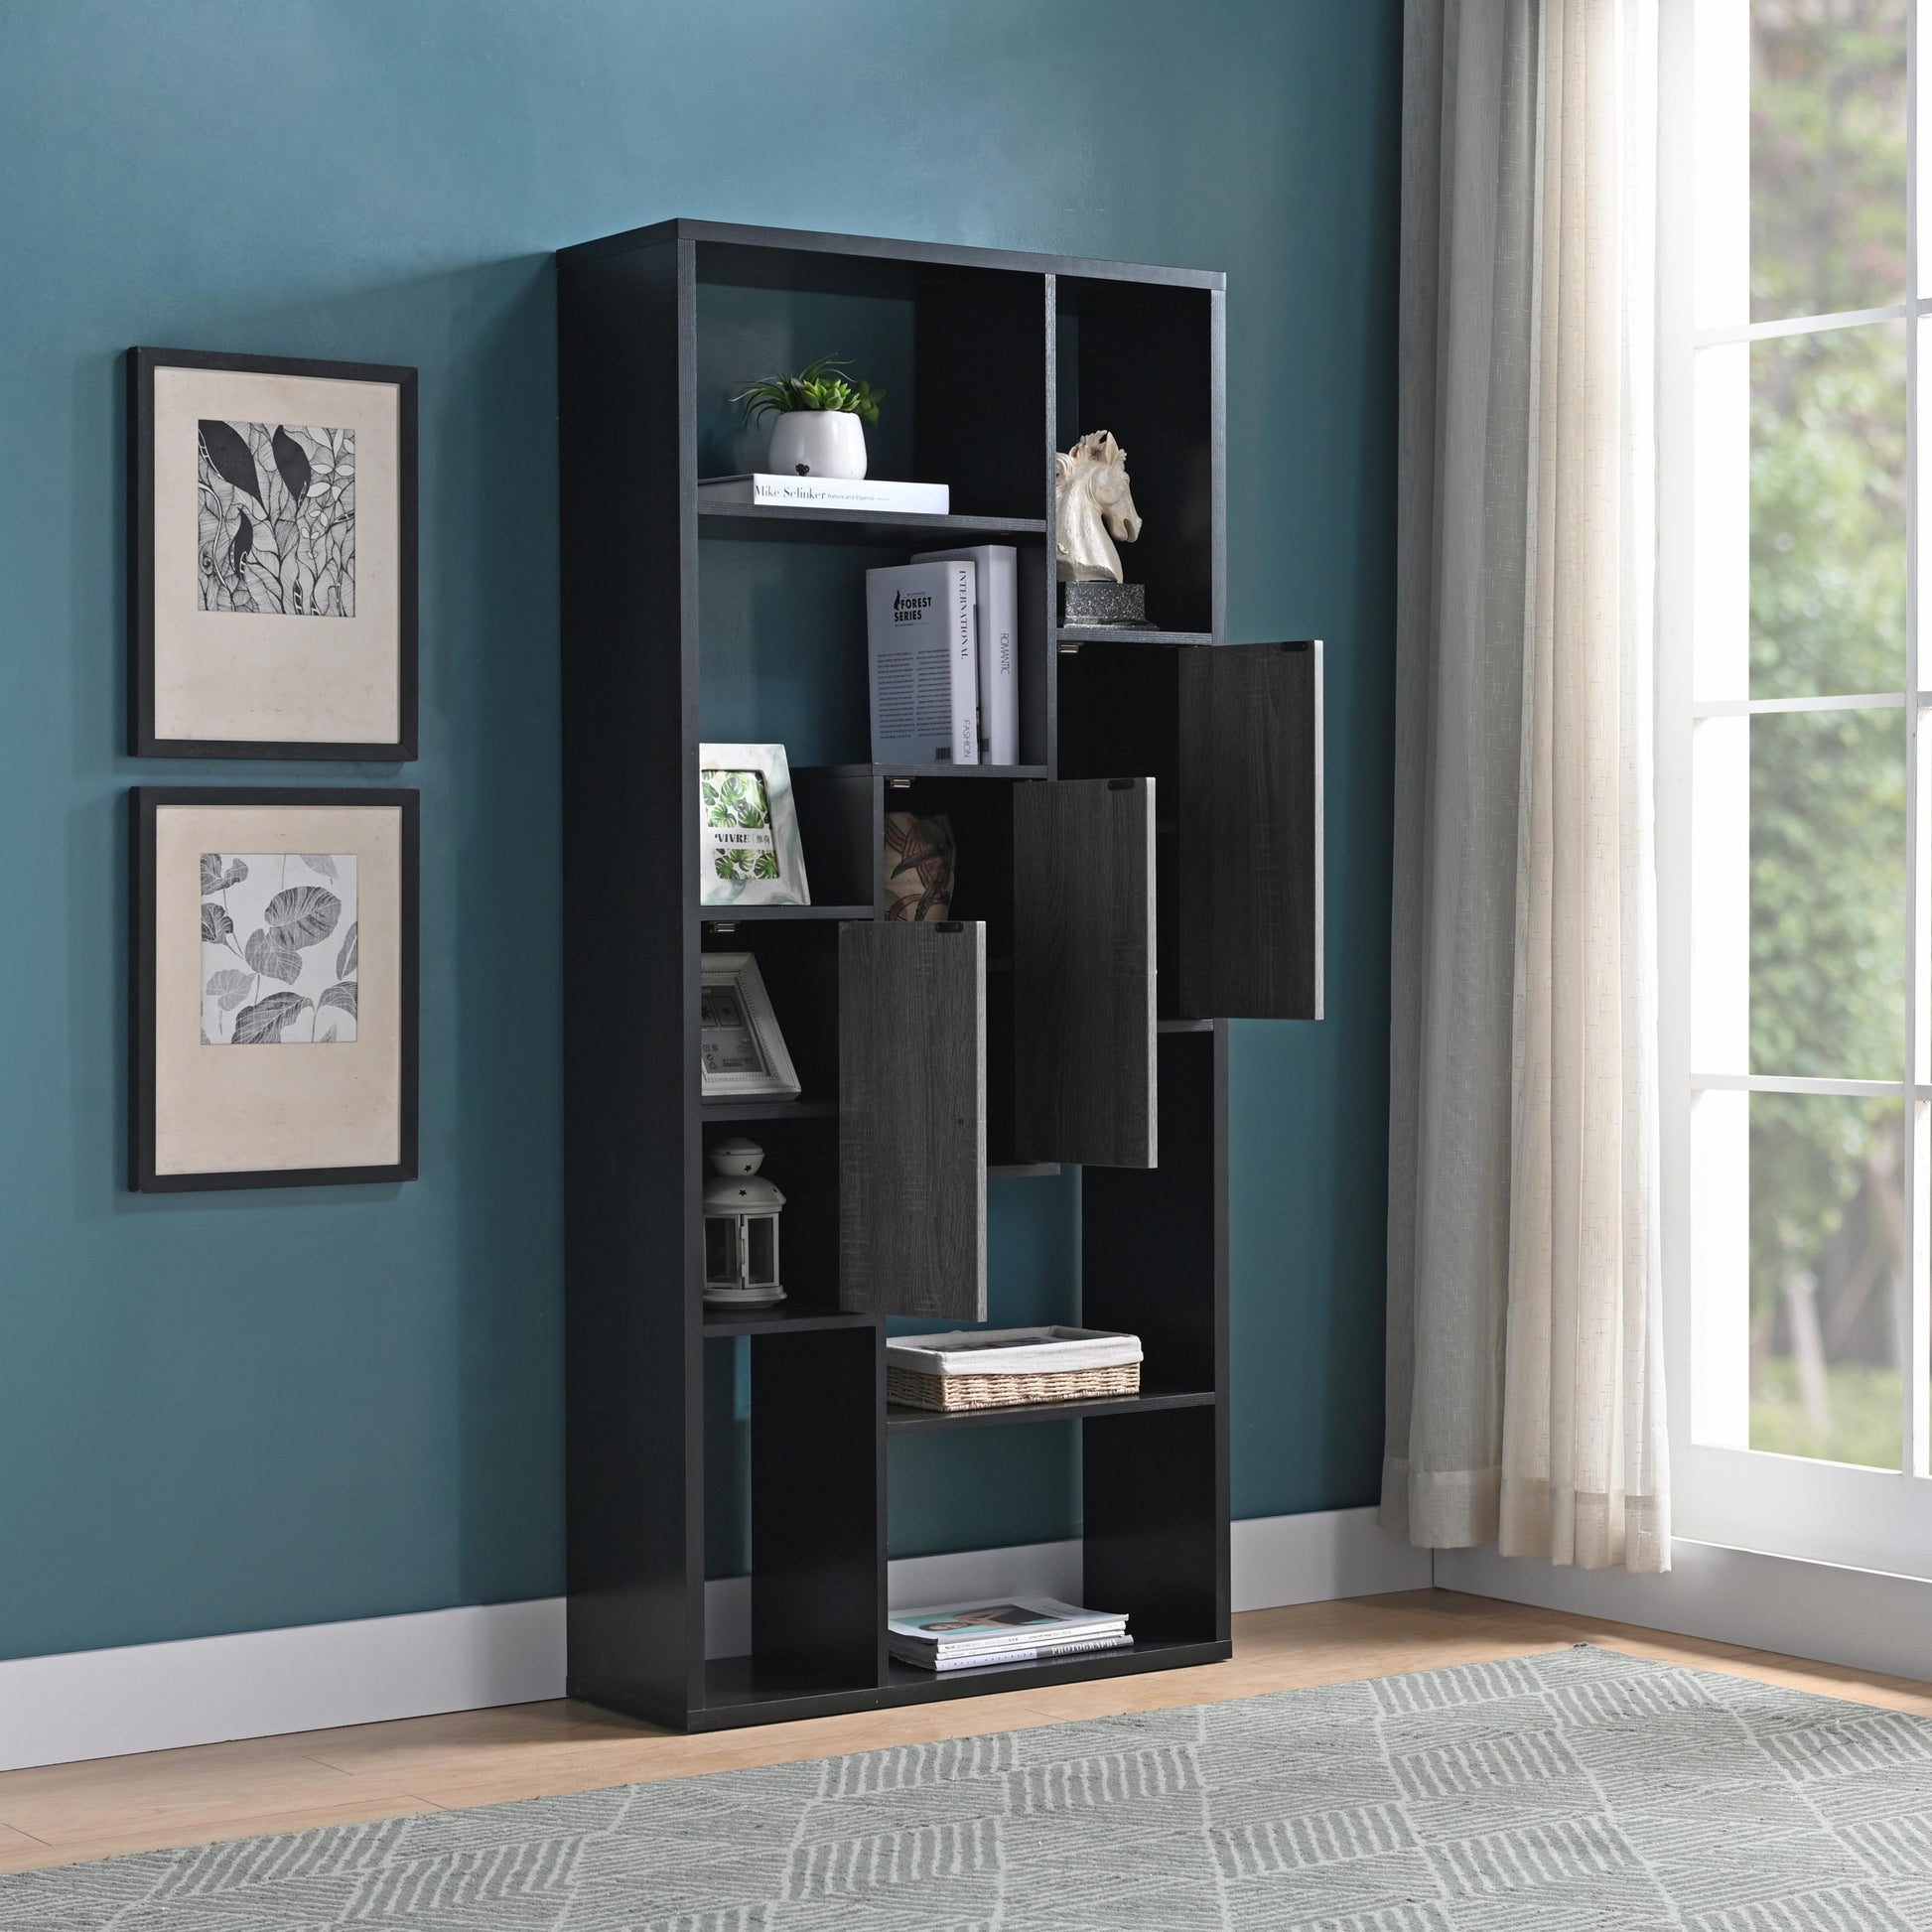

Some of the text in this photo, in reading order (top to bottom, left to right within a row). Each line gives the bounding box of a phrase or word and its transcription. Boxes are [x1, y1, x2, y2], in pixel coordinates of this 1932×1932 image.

[755, 484, 826, 499] Mike Selinker
[900, 597, 932, 610] FOREST
[894, 610, 921, 622] SERIES
[960, 570, 969, 660] INTERNATIONAL
[1000, 632, 1011, 674] ROMANTIC
[962, 719, 971, 758] FASHION
[715, 833, 750, 843] VIVRE
[1051, 1638, 1118, 1655] PHOTOGRAPHY
